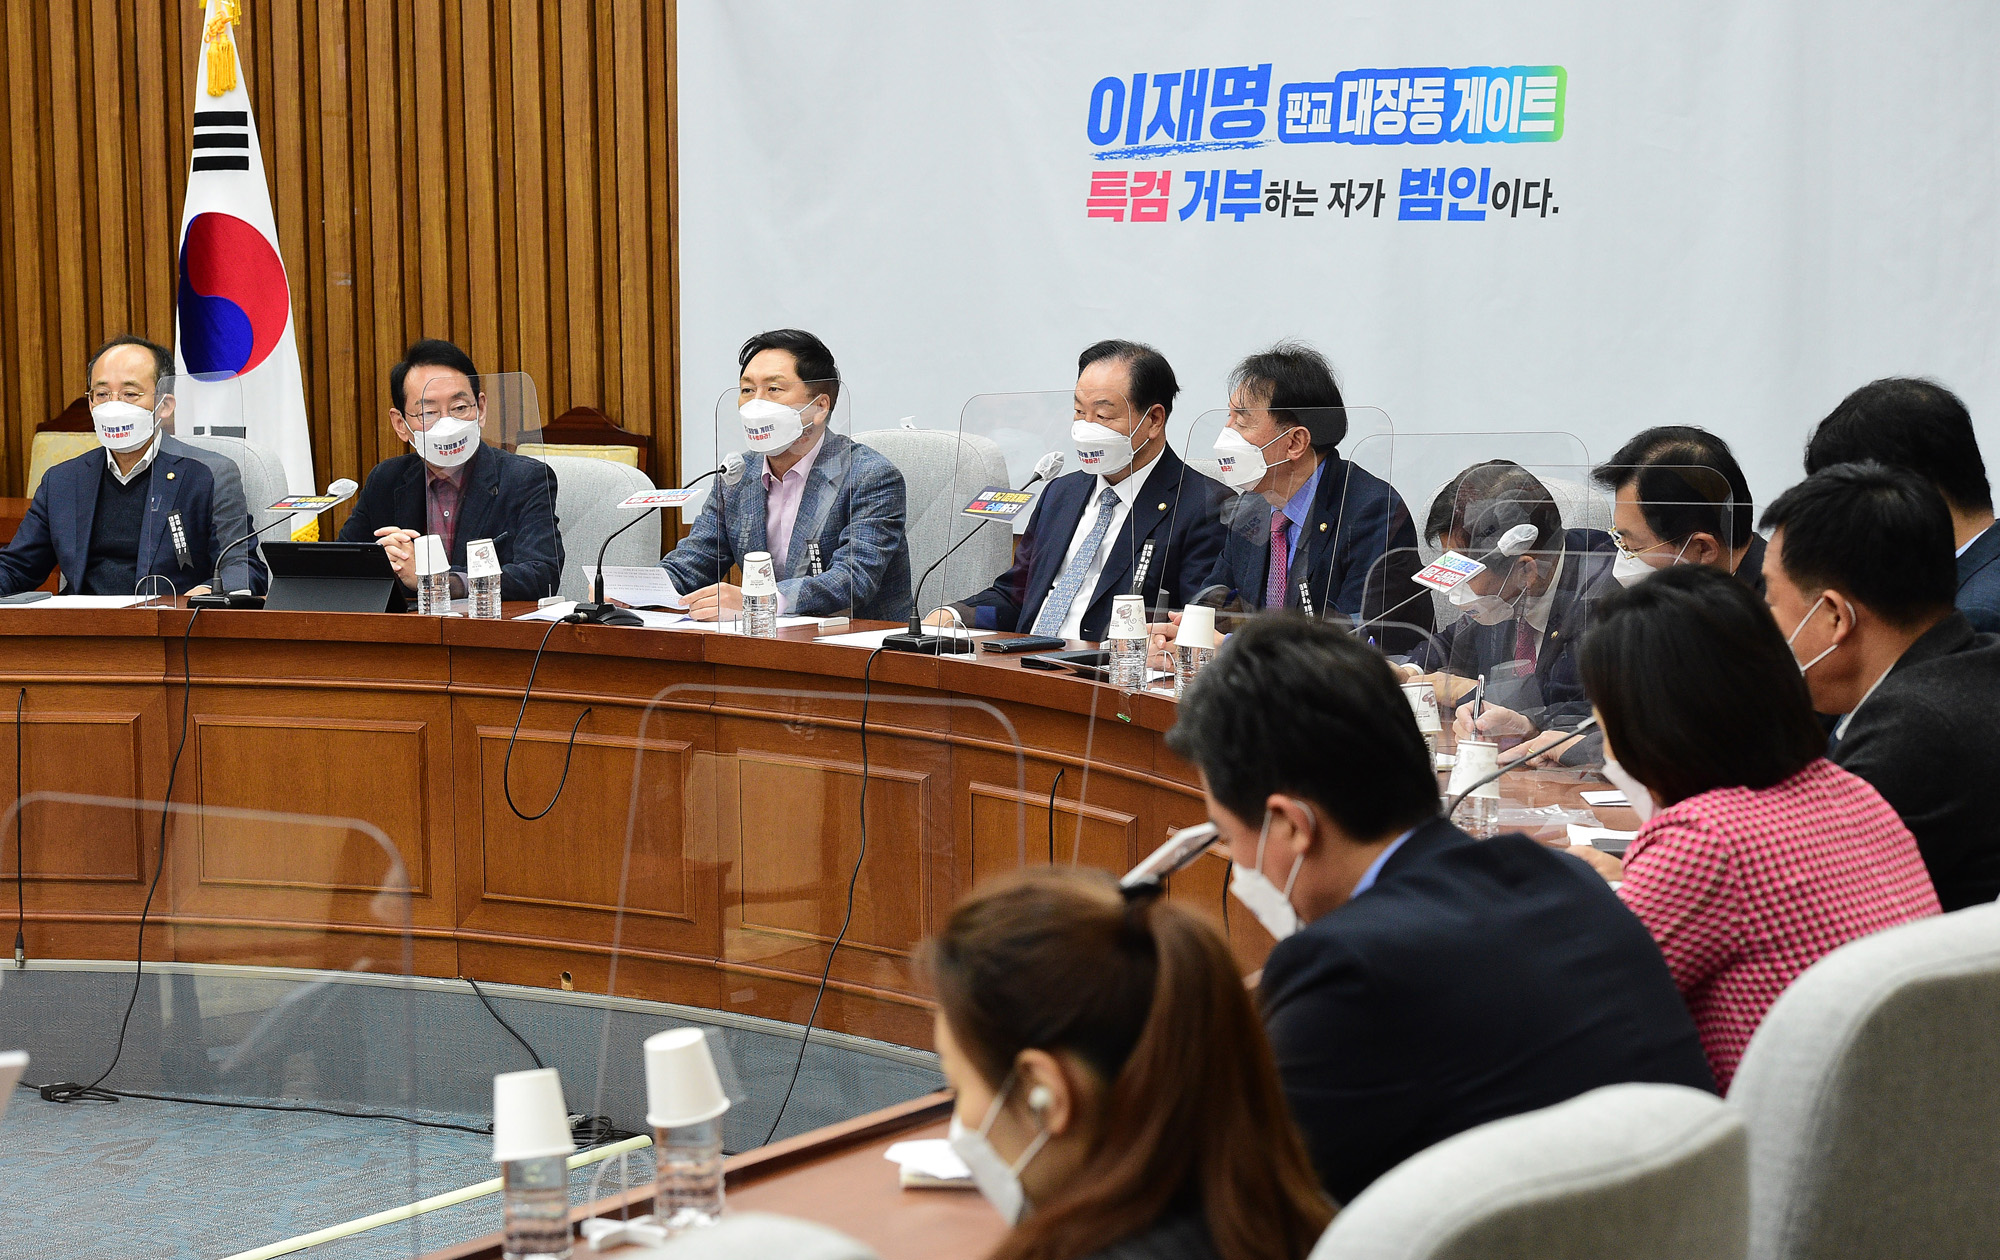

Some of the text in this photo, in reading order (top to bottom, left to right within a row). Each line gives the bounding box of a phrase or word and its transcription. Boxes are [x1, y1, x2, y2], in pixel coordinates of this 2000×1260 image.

[1087, 63, 1558, 145] 이재명 판교 대장동 게이트
[1087, 167, 1559, 222] 특검 거부하는 자가 범인이다.
